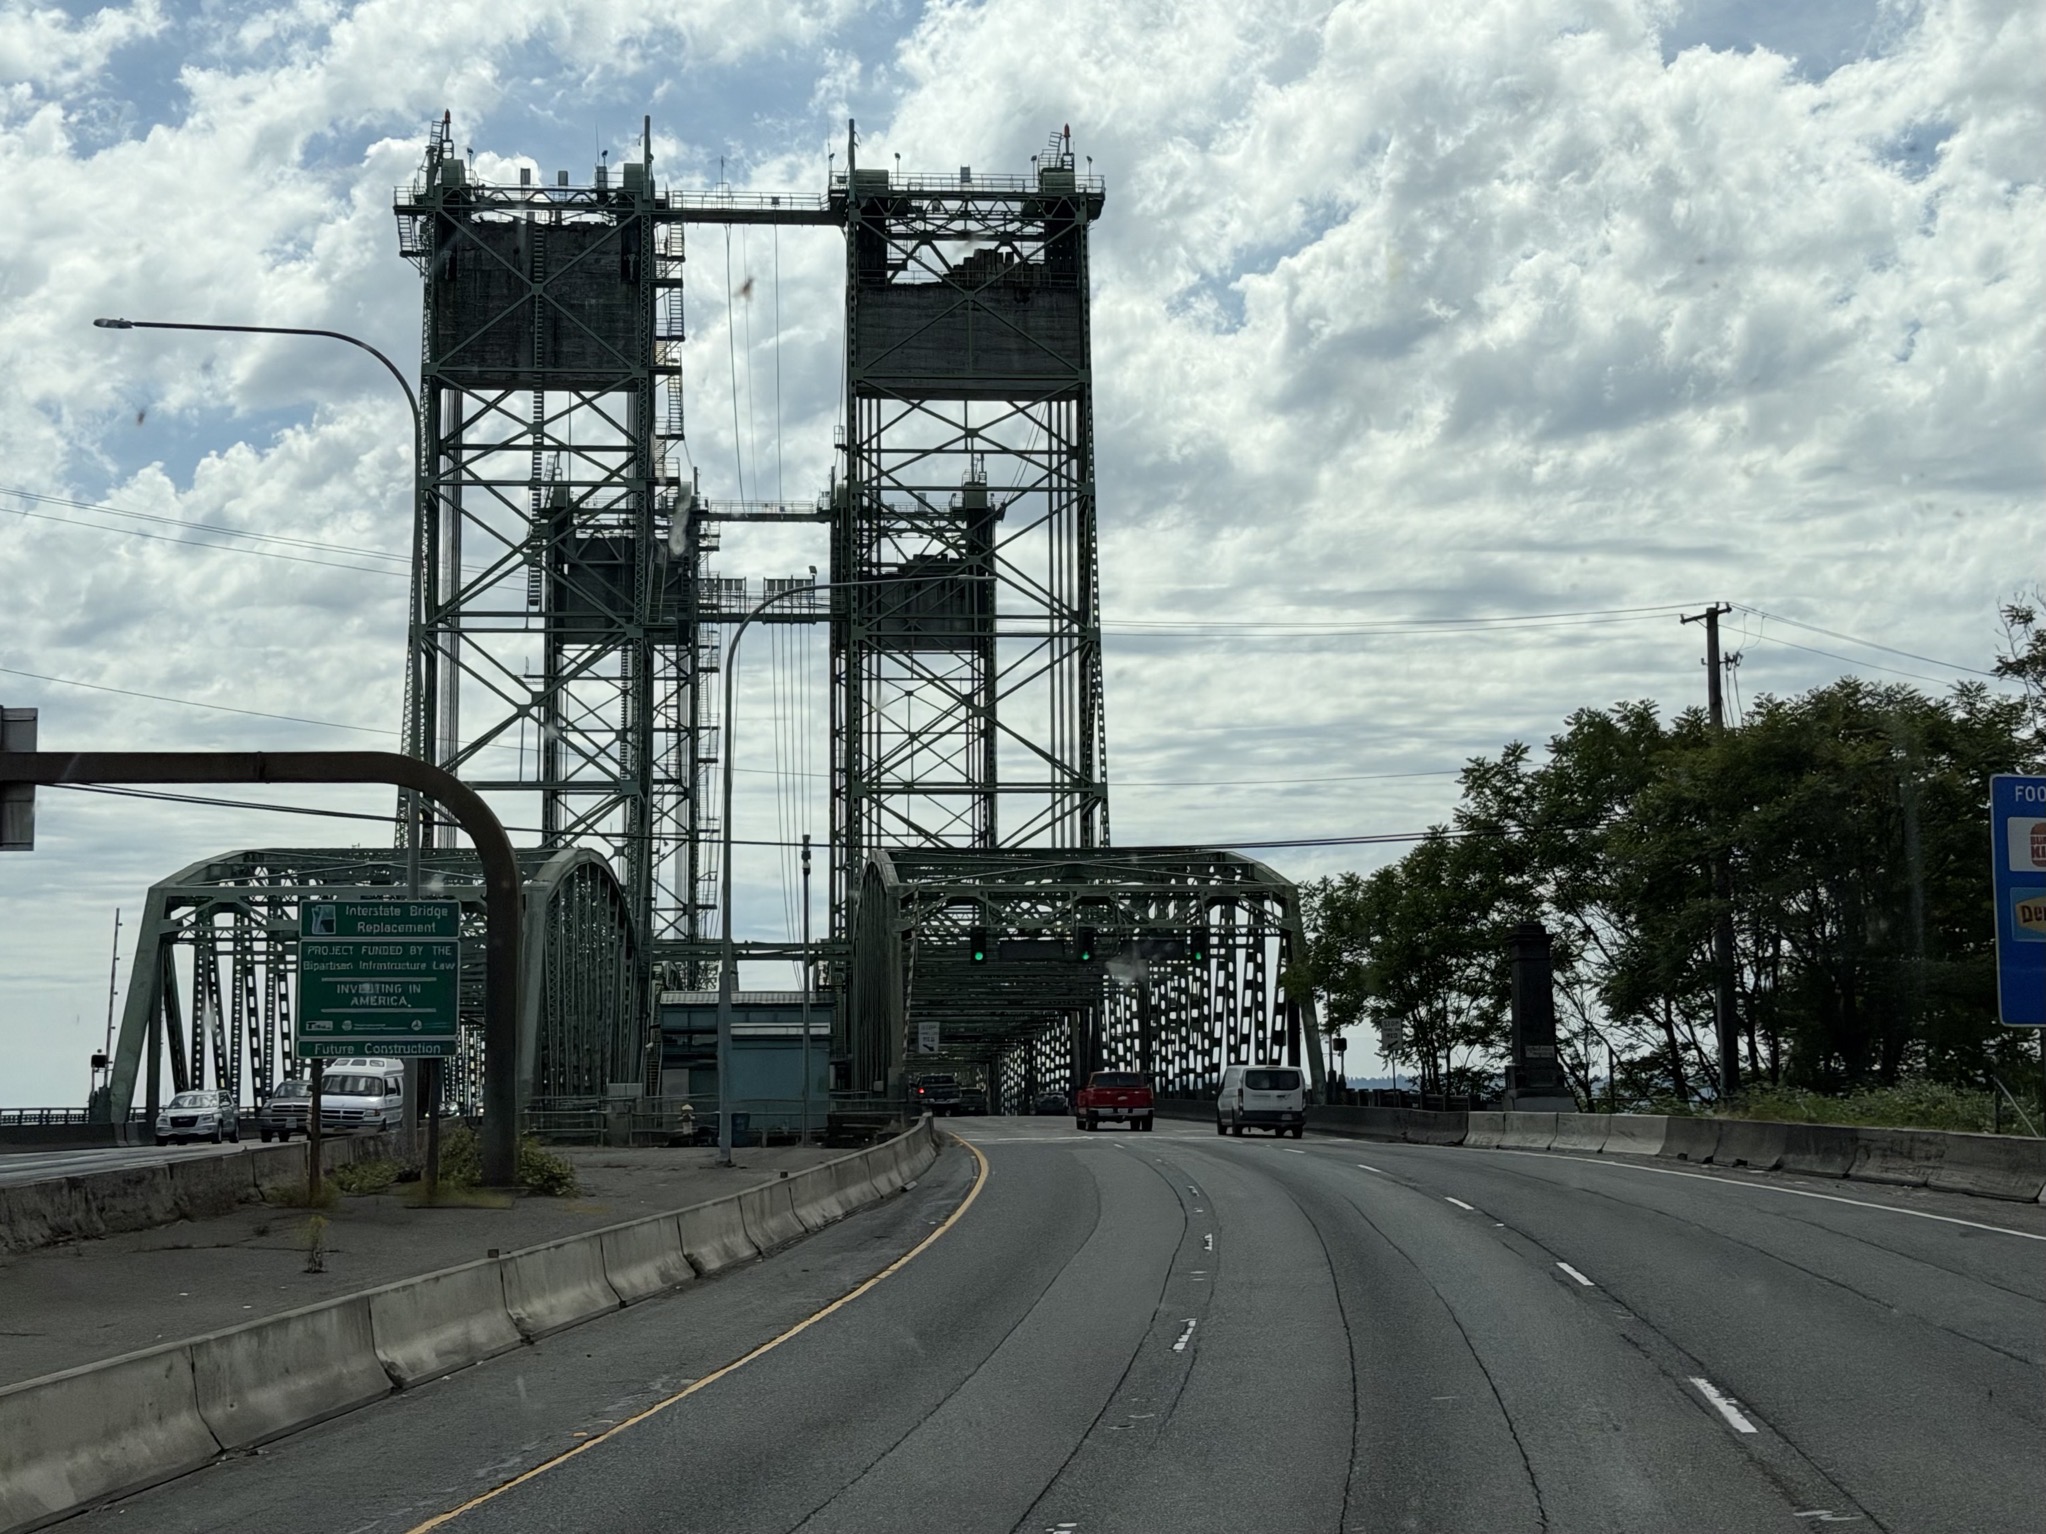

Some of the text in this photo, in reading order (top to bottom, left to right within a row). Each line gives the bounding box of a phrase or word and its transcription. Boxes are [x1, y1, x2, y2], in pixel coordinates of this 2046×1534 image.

[346, 905, 448, 919] Interstate Bridge
[357, 921, 436, 935] Replacement
[307, 946, 452, 955] PROJECT FUNDED BY THE
[303, 961, 456, 972] Bipartisan Infrastructure Law
[409, 984, 421, 993] IN
[350, 996, 412, 1008] AMERICA.
[314, 1043, 441, 1055] Future Construction
